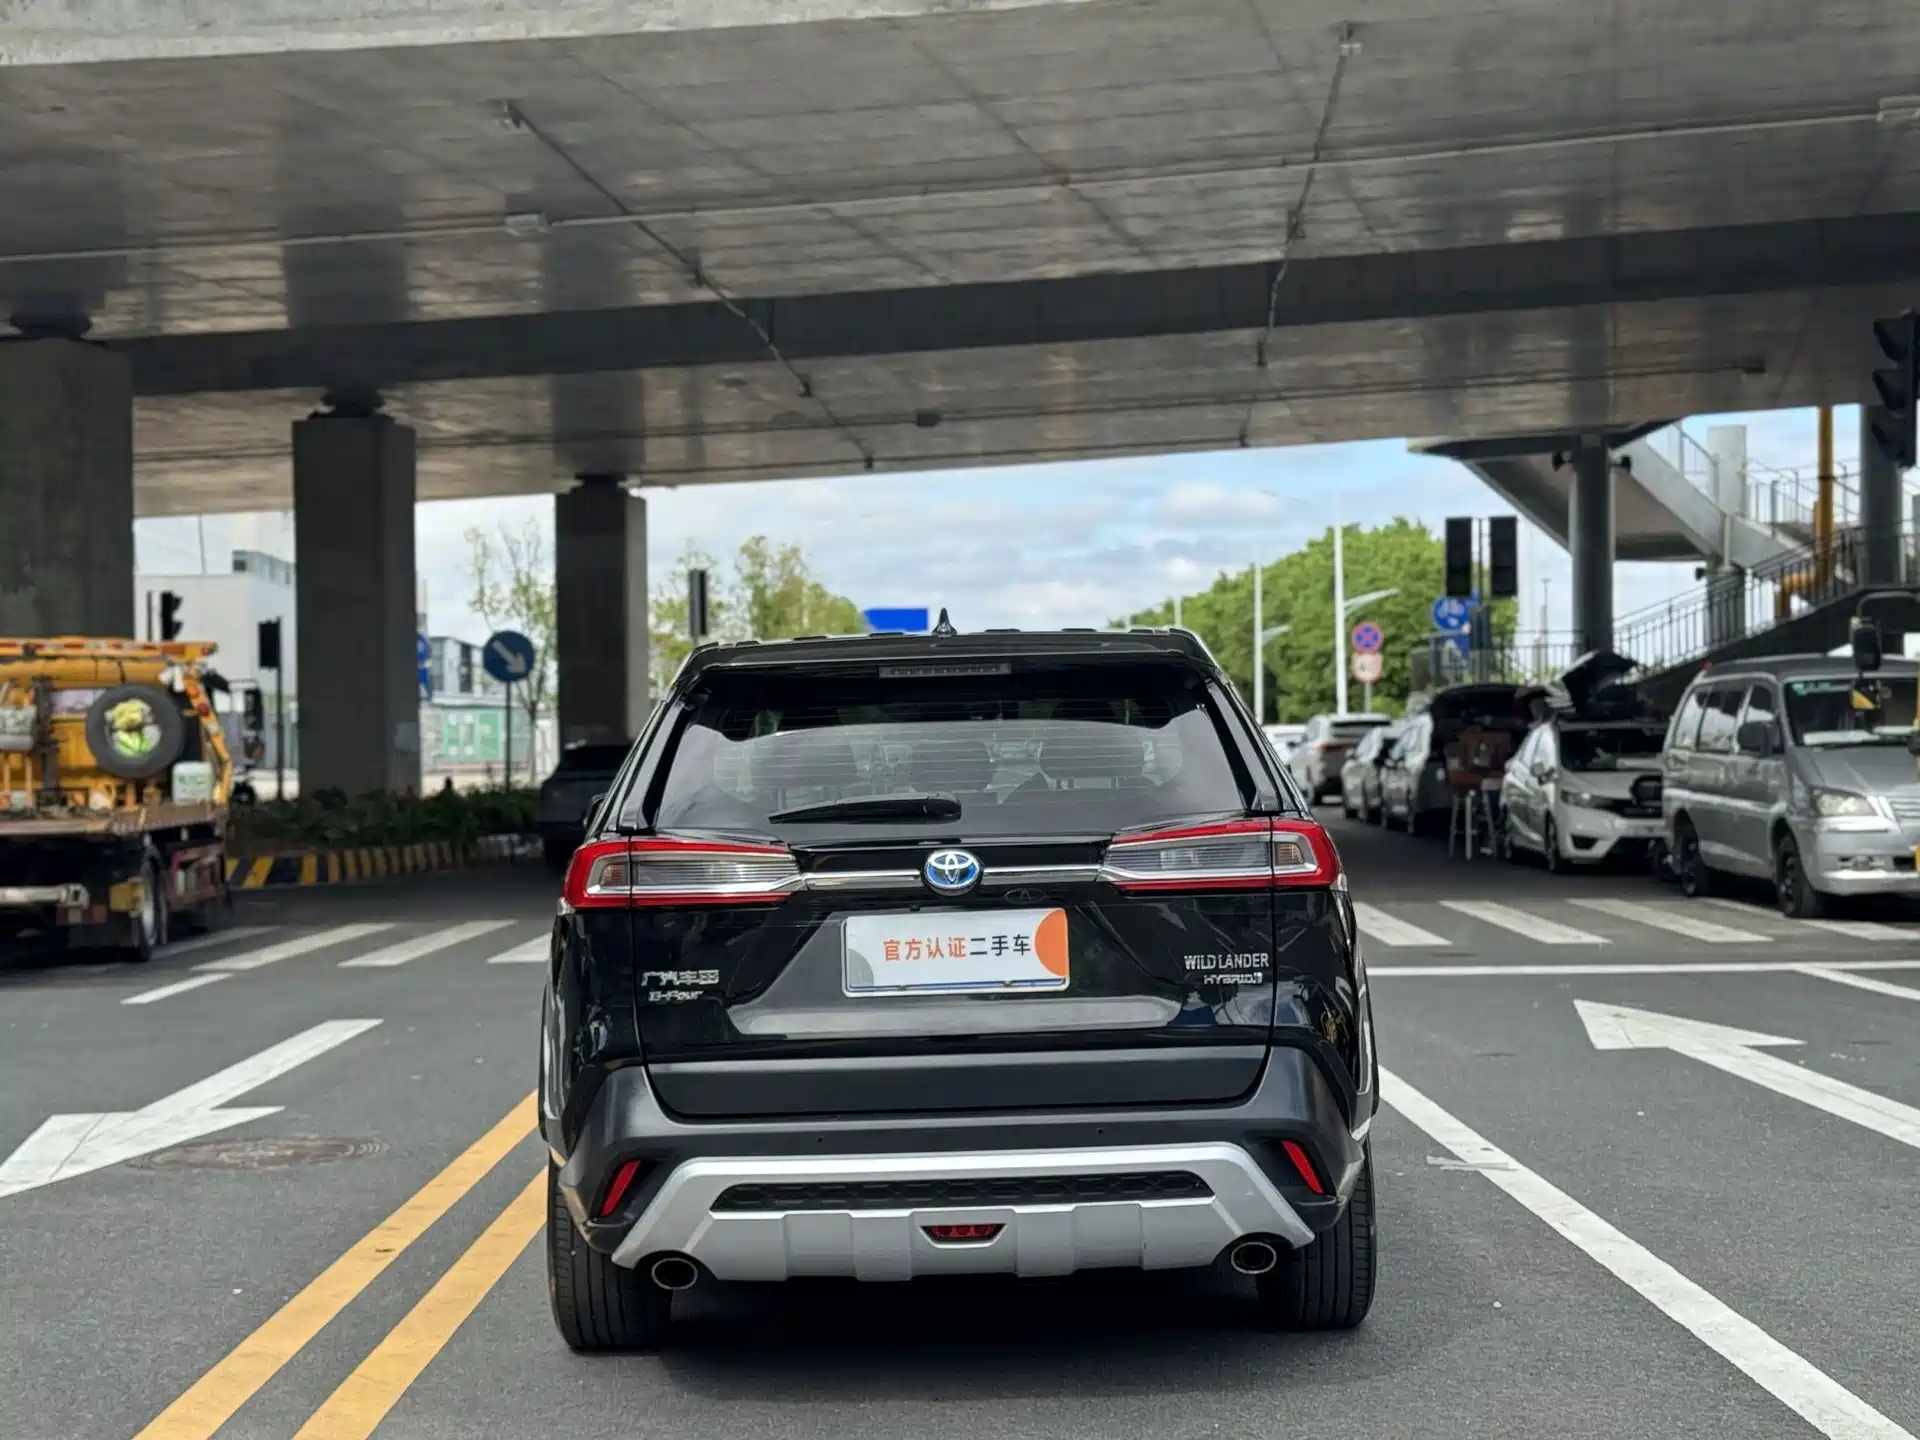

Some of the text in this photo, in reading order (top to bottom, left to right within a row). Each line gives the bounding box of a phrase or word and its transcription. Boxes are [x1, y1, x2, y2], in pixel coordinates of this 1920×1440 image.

[883, 934, 1032, 961] 官方认证二手车
